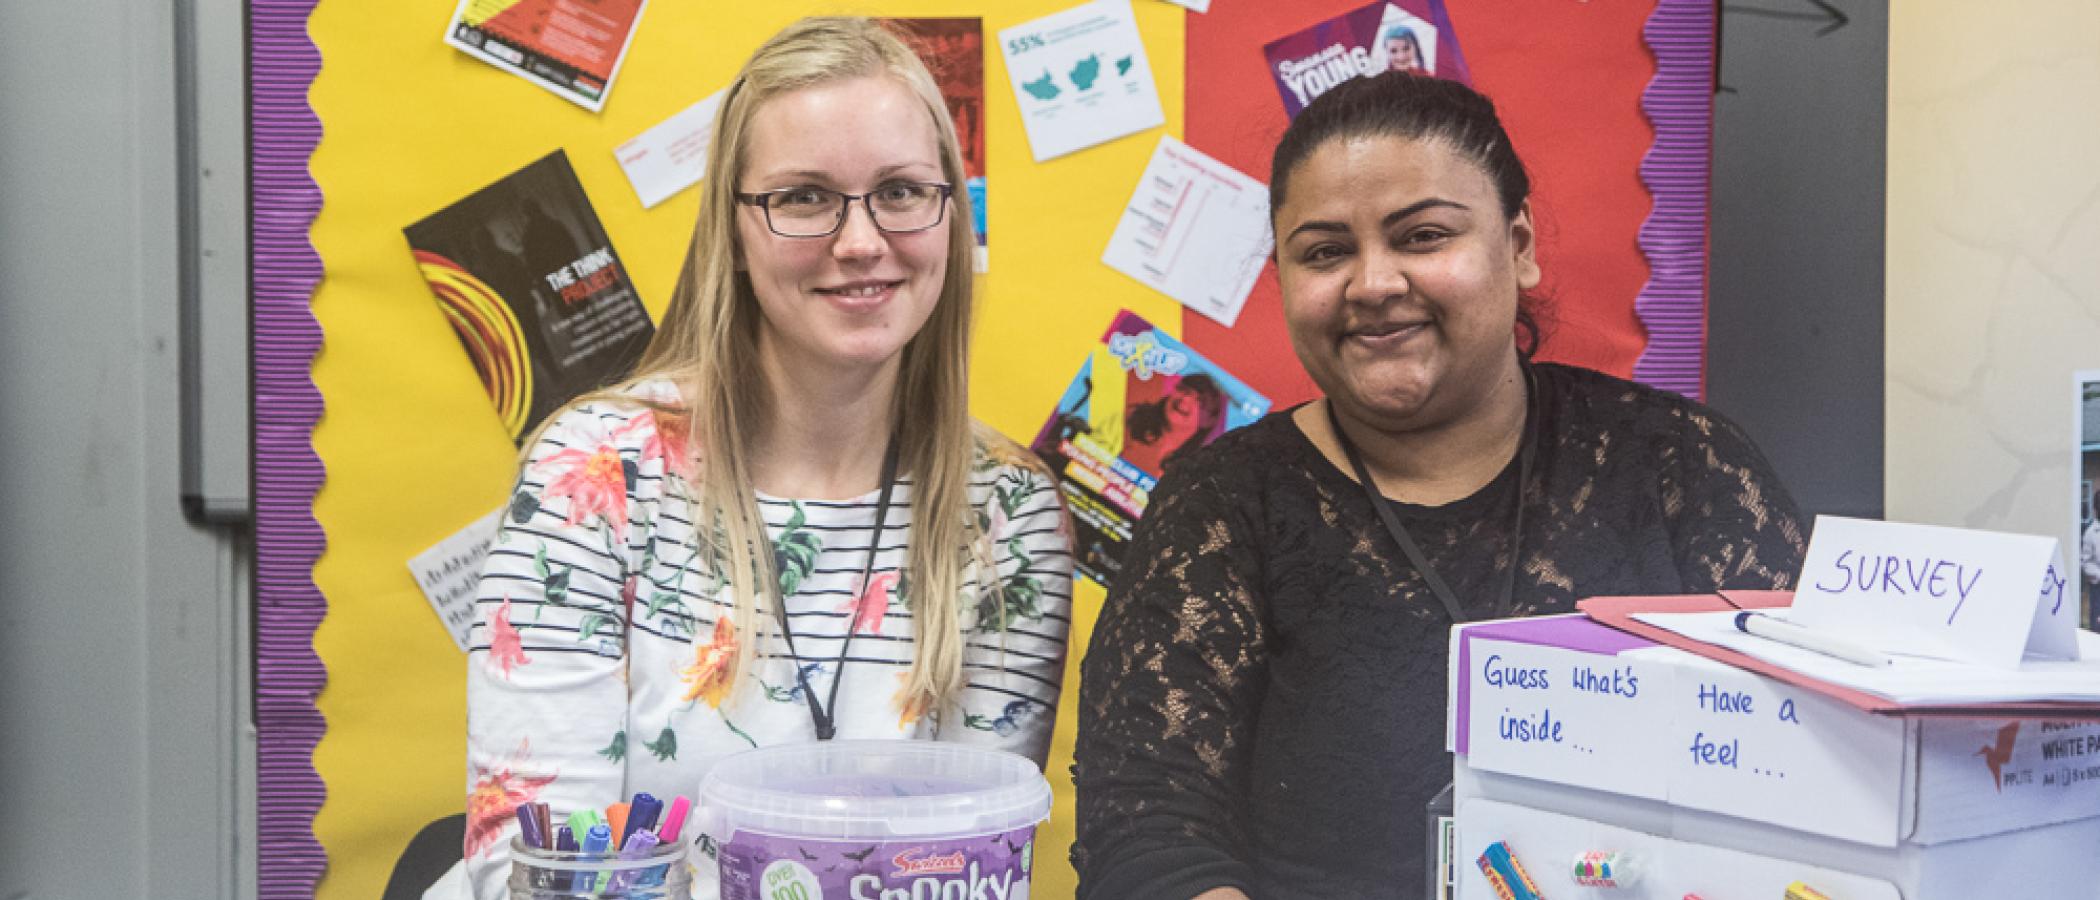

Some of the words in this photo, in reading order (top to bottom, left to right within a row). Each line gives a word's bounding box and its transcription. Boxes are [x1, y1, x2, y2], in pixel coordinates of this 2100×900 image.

[1008, 33, 1045, 55] 55%
[1283, 46, 1368, 108] YOUNG
[545, 266, 576, 292] THE
[571, 246, 614, 278] THINK
[561, 262, 618, 304] PROJECT
[1816, 550, 1982, 625] SURVEY
[1484, 655, 1549, 689] Guess
[1572, 665, 1639, 698] What's
[1500, 708, 1564, 742] inside
[1698, 683, 1754, 714] Have
[1778, 698, 1801, 725] a
[1689, 732, 1739, 769] feel
[2041, 737, 2083, 761] WHITE
[850, 860, 1013, 900] Sooky
